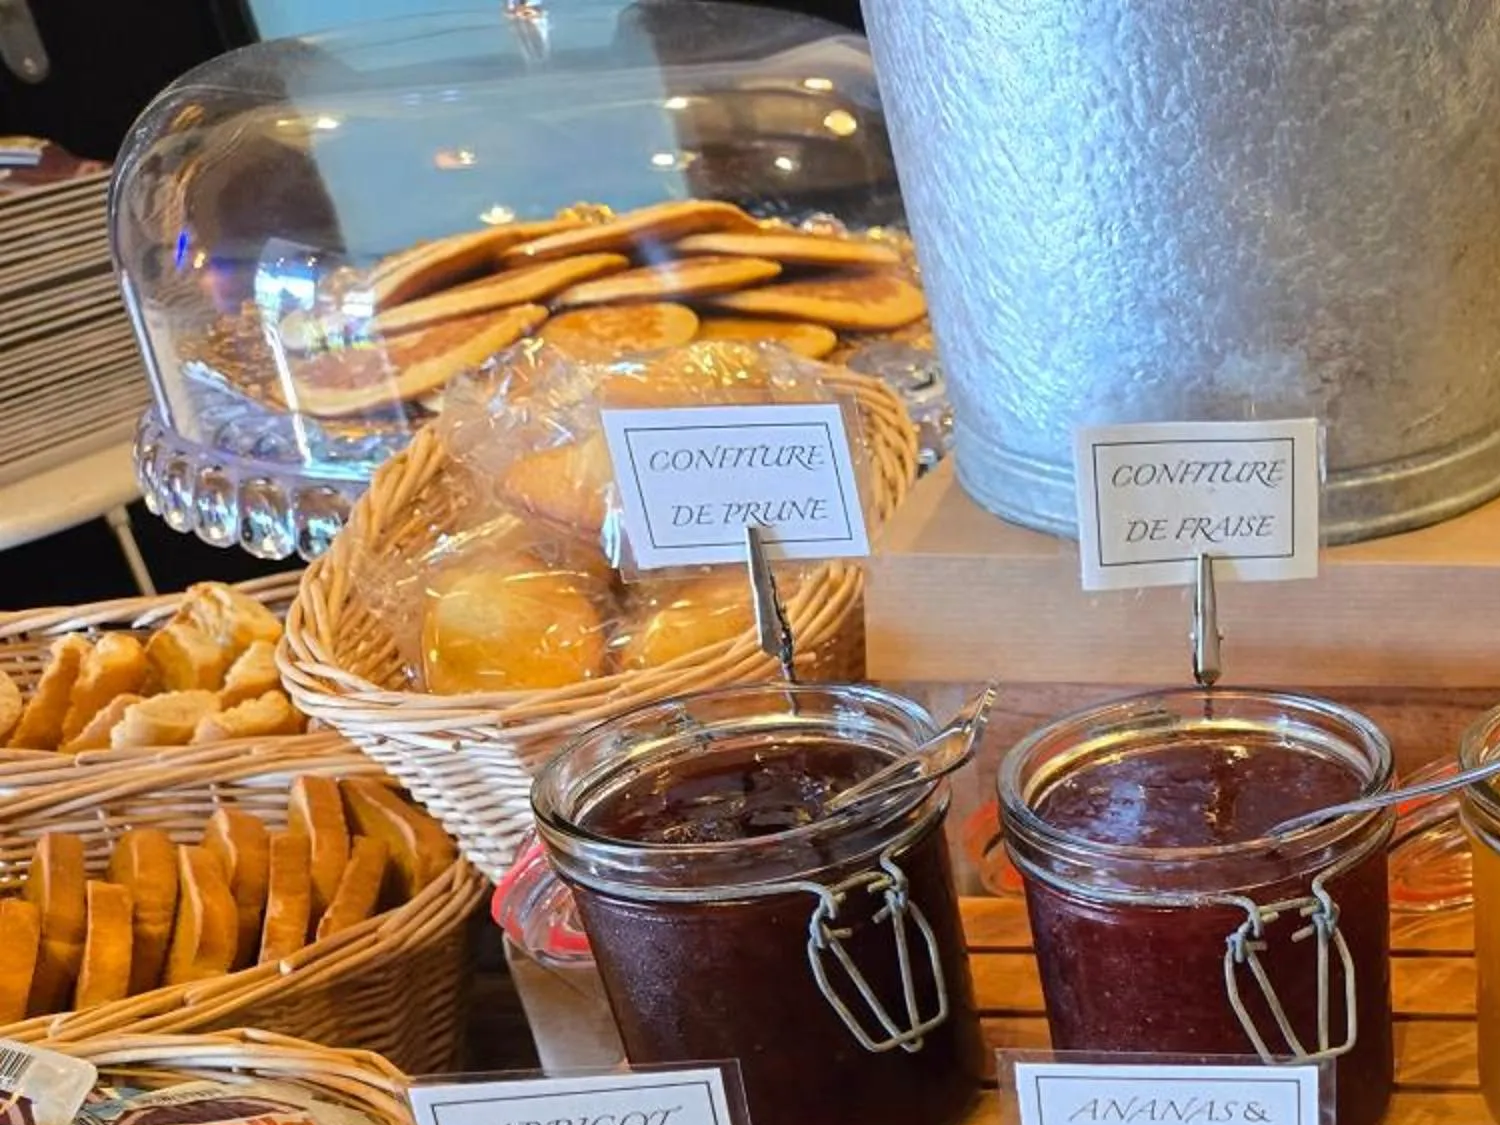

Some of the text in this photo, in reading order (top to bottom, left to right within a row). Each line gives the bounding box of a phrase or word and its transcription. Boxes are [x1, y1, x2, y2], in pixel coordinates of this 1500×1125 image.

[649, 444, 826, 472] CONFITURE
[1111, 458, 1286, 488] CONFITURE
[671, 498, 829, 528] DE PRUNE
[1126, 515, 1276, 543] DE FRAISE
